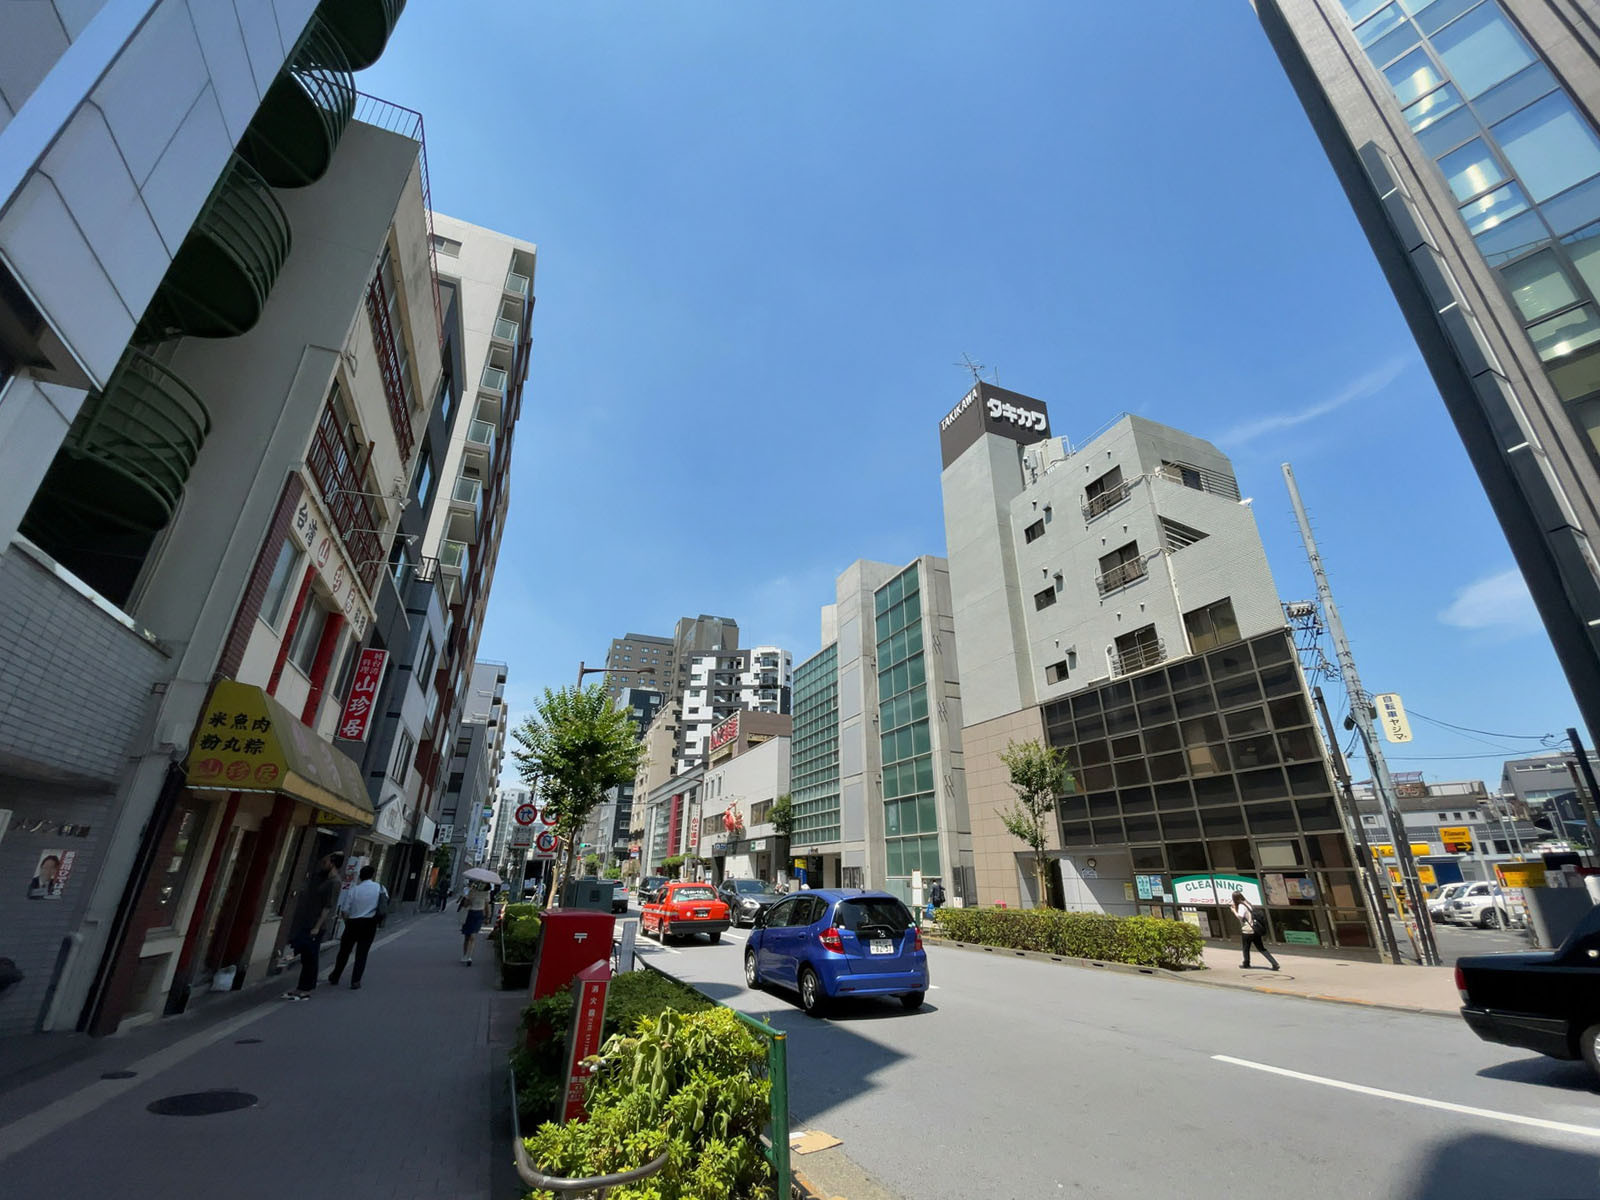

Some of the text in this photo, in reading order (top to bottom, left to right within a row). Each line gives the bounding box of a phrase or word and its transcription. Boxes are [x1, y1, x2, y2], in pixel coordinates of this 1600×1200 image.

[941, 389, 978, 431] TAKIKAWA
[987, 398, 1047, 431] タキカワ
[342, 675, 375, 737] 山珍居
[1383, 696, 1404, 740] 自転車ヤジマ
[1185, 880, 1244, 893] CLEANING
